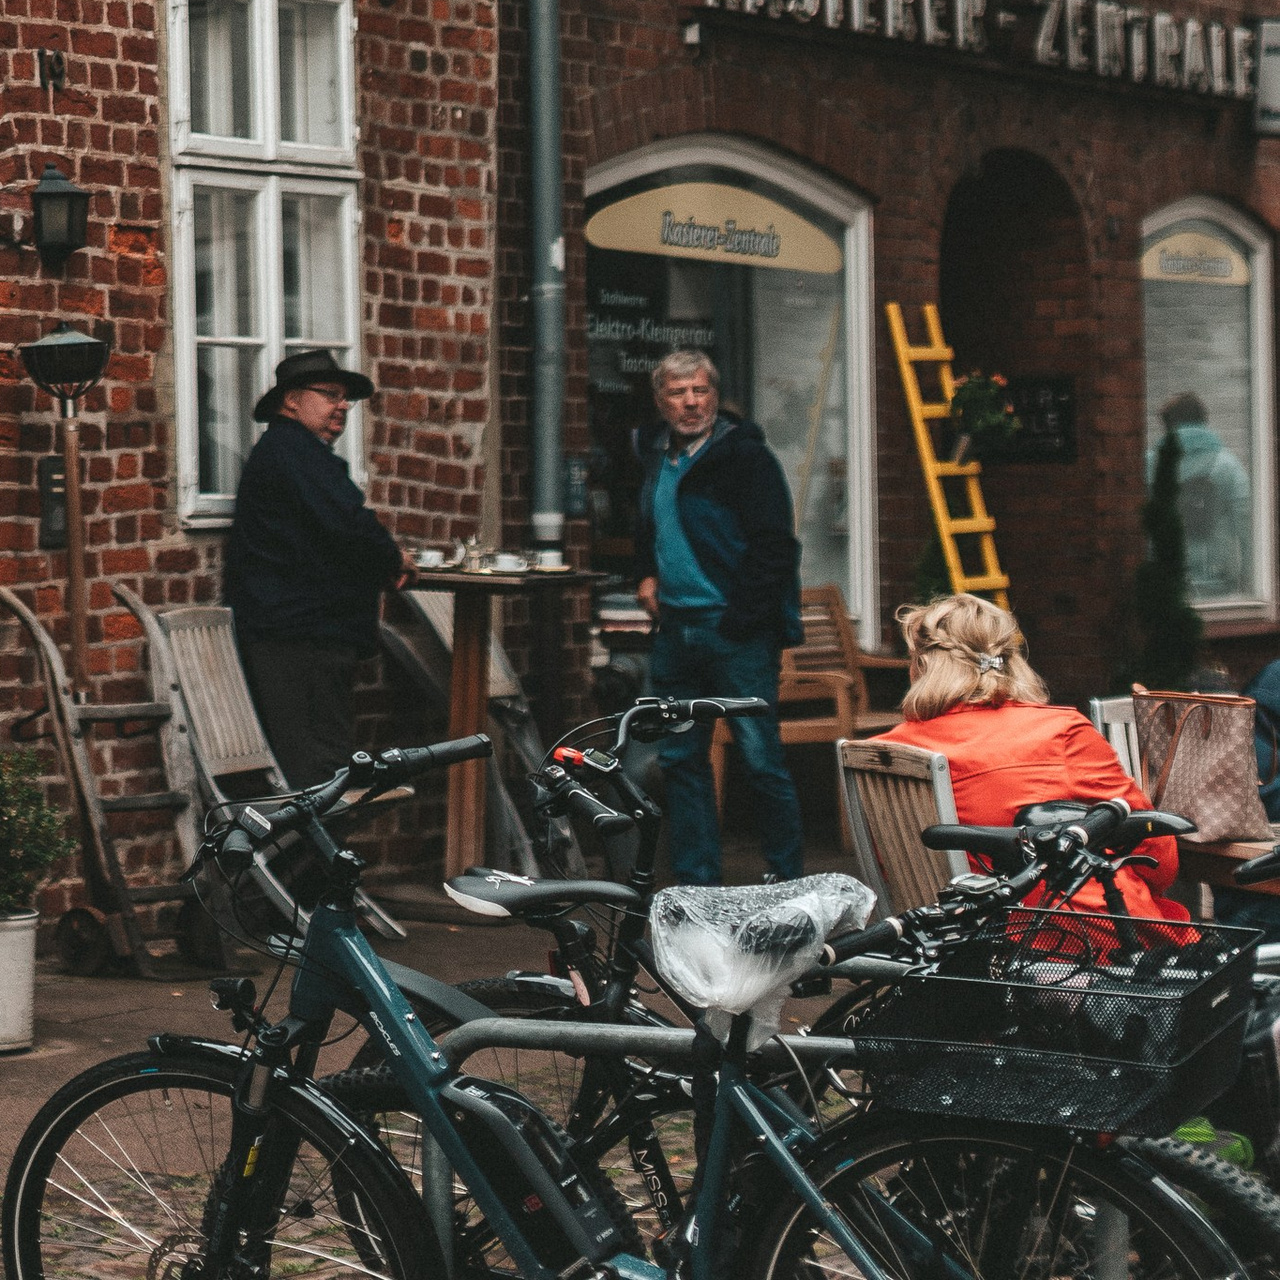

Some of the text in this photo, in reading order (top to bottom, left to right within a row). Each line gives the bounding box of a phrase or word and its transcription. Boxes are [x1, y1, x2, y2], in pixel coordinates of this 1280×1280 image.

[37, 47, 65, 92] 19
[369, 1011, 402, 1057] BICYCLES
[636, 1149, 668, 1208] MISS
